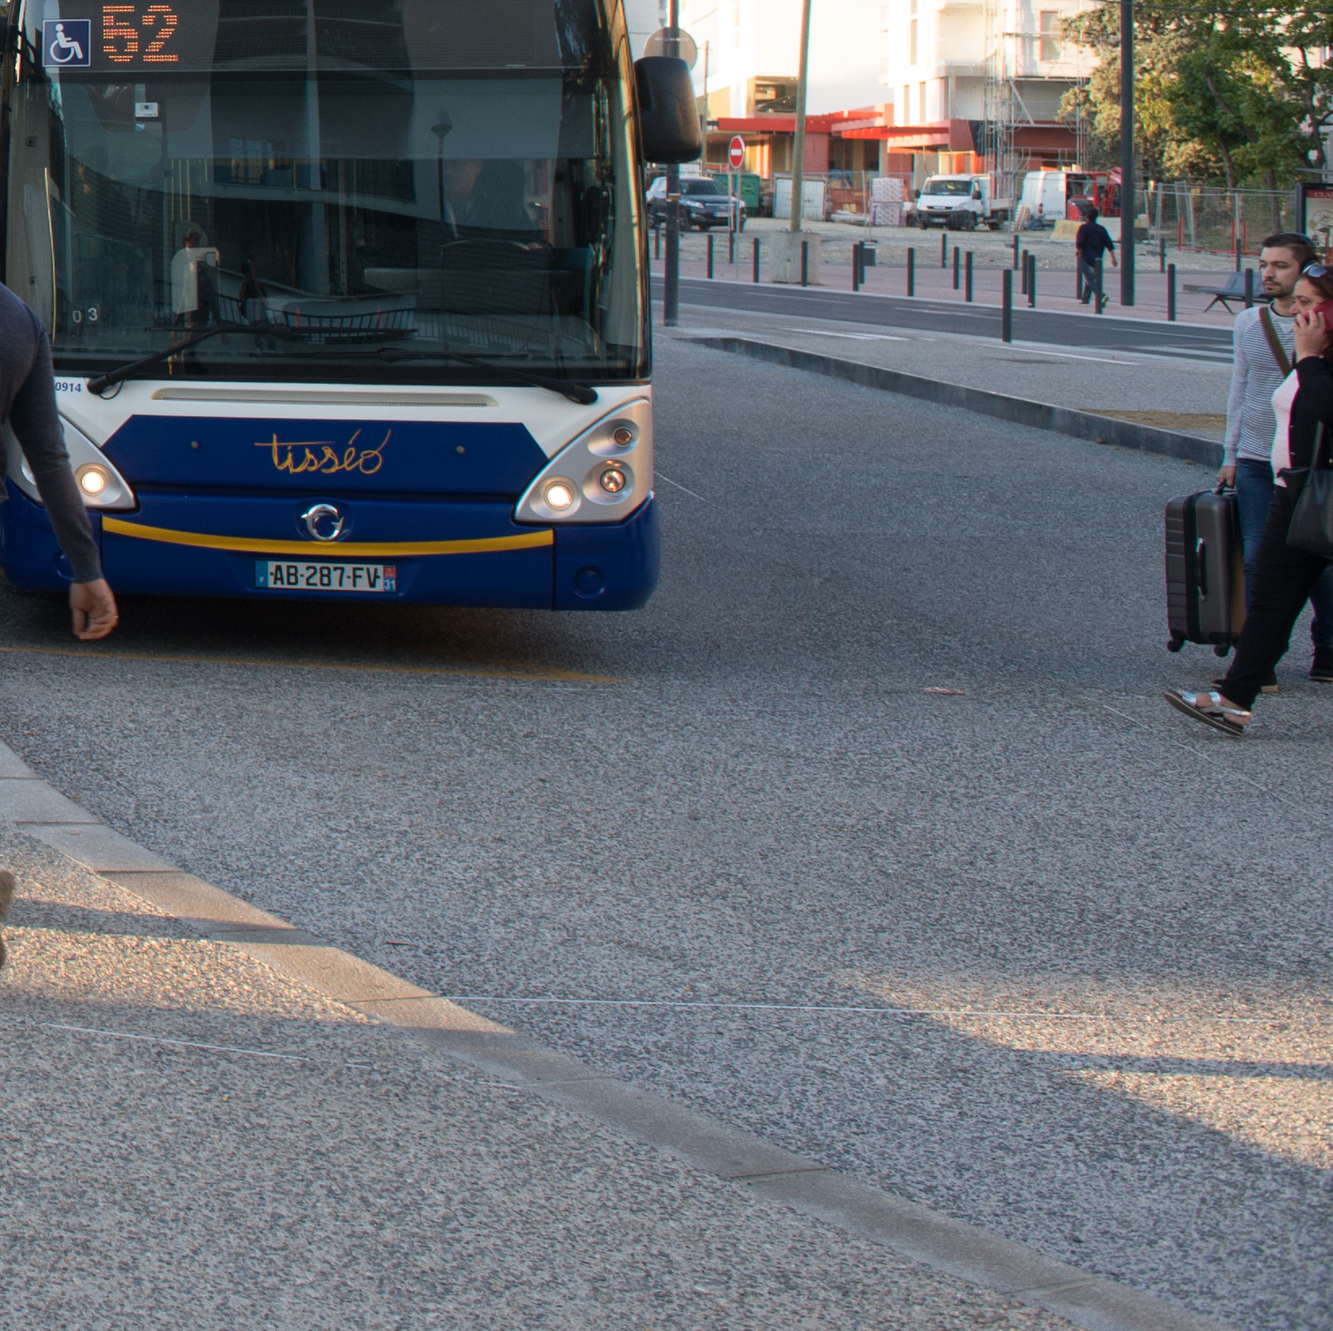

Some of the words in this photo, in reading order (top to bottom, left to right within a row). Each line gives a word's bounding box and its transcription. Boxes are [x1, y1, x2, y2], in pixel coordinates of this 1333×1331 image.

[102, 4, 179, 62] 52
[55, 381, 82, 392] 0914
[254, 428, 392, 474] tisséo
[384, 579, 396, 591] 31
